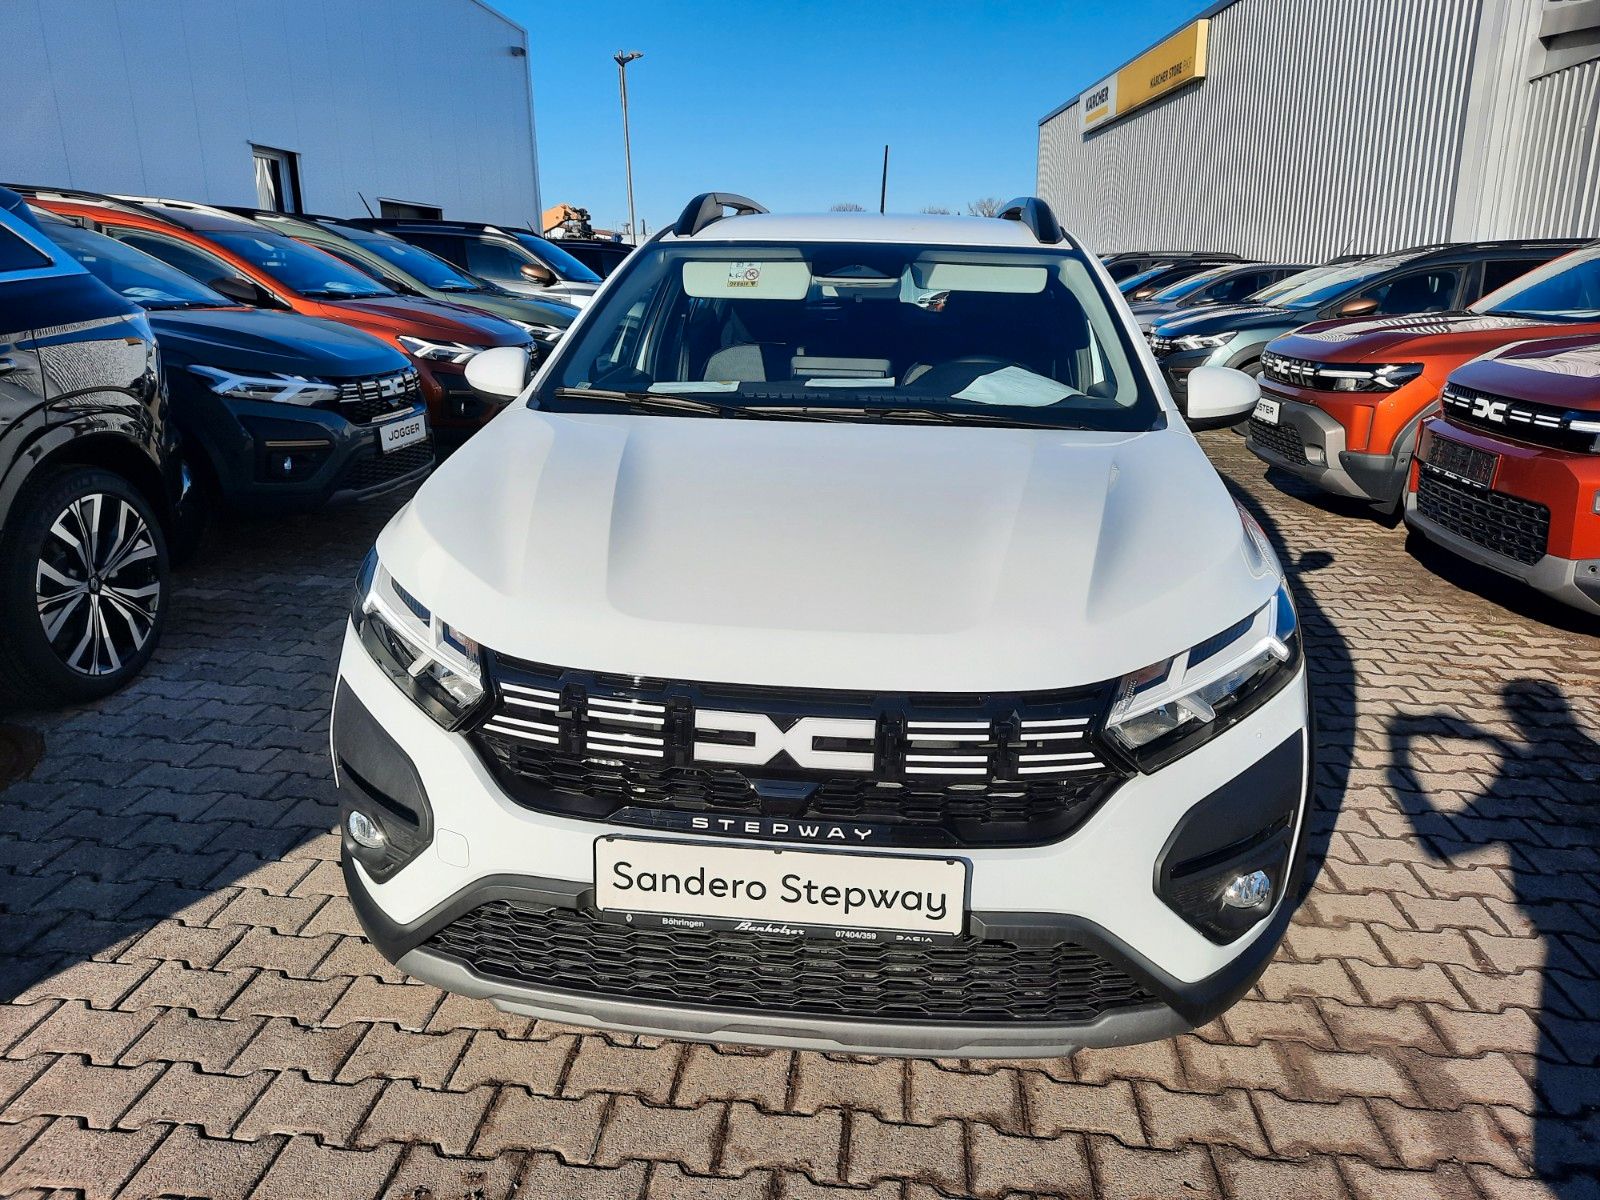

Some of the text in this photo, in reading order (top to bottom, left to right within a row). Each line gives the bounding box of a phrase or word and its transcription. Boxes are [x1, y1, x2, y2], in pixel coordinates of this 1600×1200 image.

[1169, 61, 1182, 80] STORE
[1256, 403, 1274, 415] STER
[388, 423, 420, 441] JOGGER
[692, 817, 873, 840] STEPWAY
[612, 861, 947, 920] Sandero Stepway
[661, 917, 704, 928] Böhringen
[835, 930, 877, 940] 07404/359
[896, 935, 933, 943] DACIA
